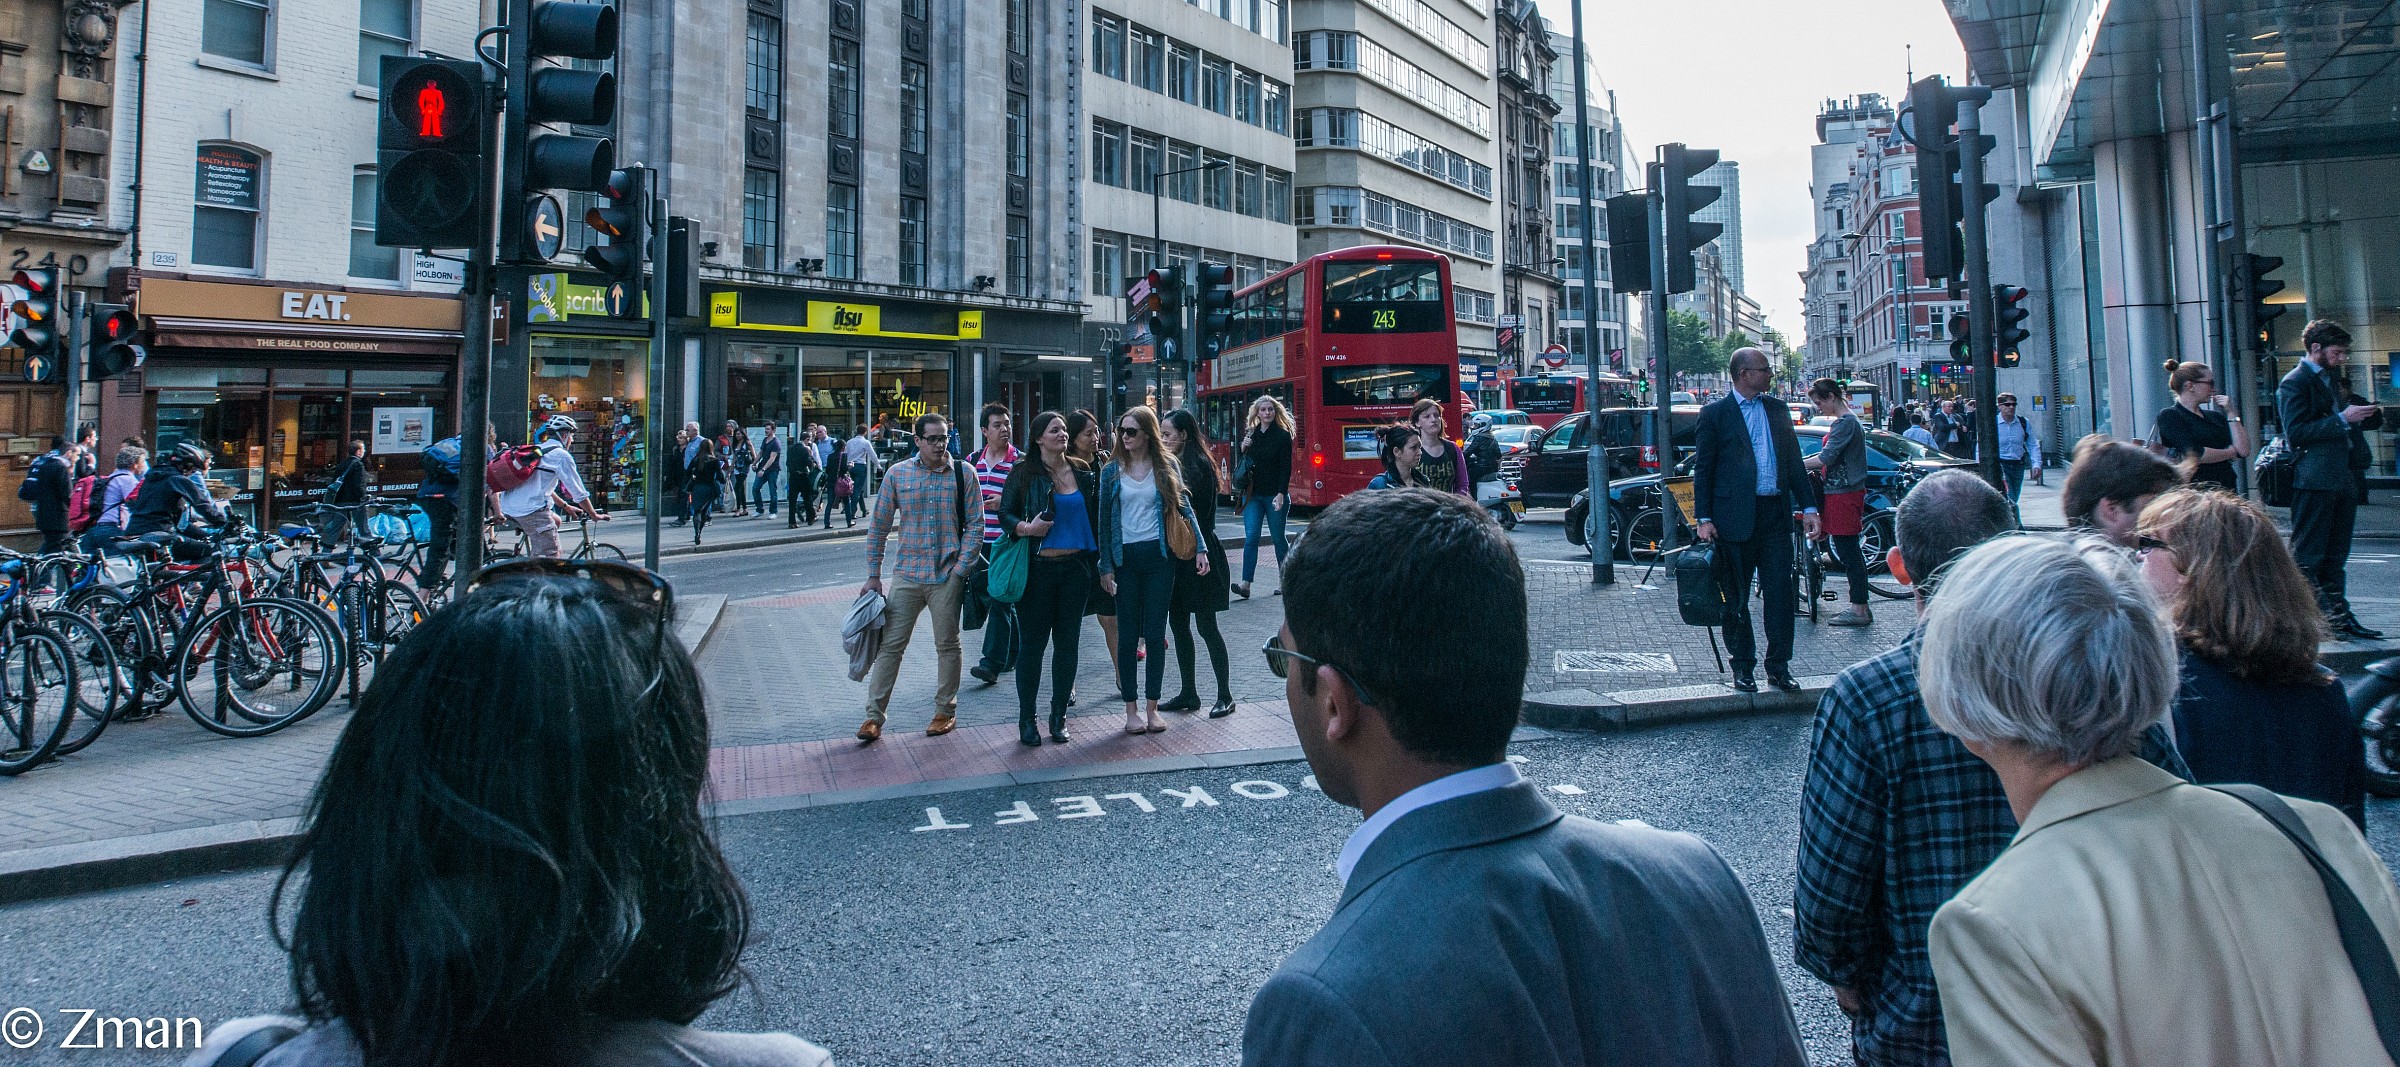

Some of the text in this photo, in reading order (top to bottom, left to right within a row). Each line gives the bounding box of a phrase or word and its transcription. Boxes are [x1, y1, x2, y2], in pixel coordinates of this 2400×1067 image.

[198, 156, 223, 166] HEALTH
[231, 160, 258, 170] BEAUTY
[207, 164, 246, 174] Acupuncture
[207, 172, 250, 182] Aromatherapy
[207, 180, 242, 189] Reflexology
[207, 195, 235, 203] Massage
[11, 248, 88, 275] 240
[155, 254, 175, 264] 239
[416, 260, 435, 269] HIGH
[415, 270, 453, 280] HOLBORN
[531, 278, 561, 320] scribbler
[566, 289, 606, 313] scrib
[282, 291, 351, 321] EAT.
[715, 303, 732, 315] itsu
[834, 305, 863, 326] itsu
[1372, 310, 1396, 328] 243
[962, 319, 978, 329] itsu
[256, 338, 379, 350] THE REAL FOOD COMPANY
[899, 395, 926, 417] itsu
[382, 483, 419, 491] BREAKFAST
[274, 489, 303, 498] SALADS
[910, 791, 1157, 833] LEFT
